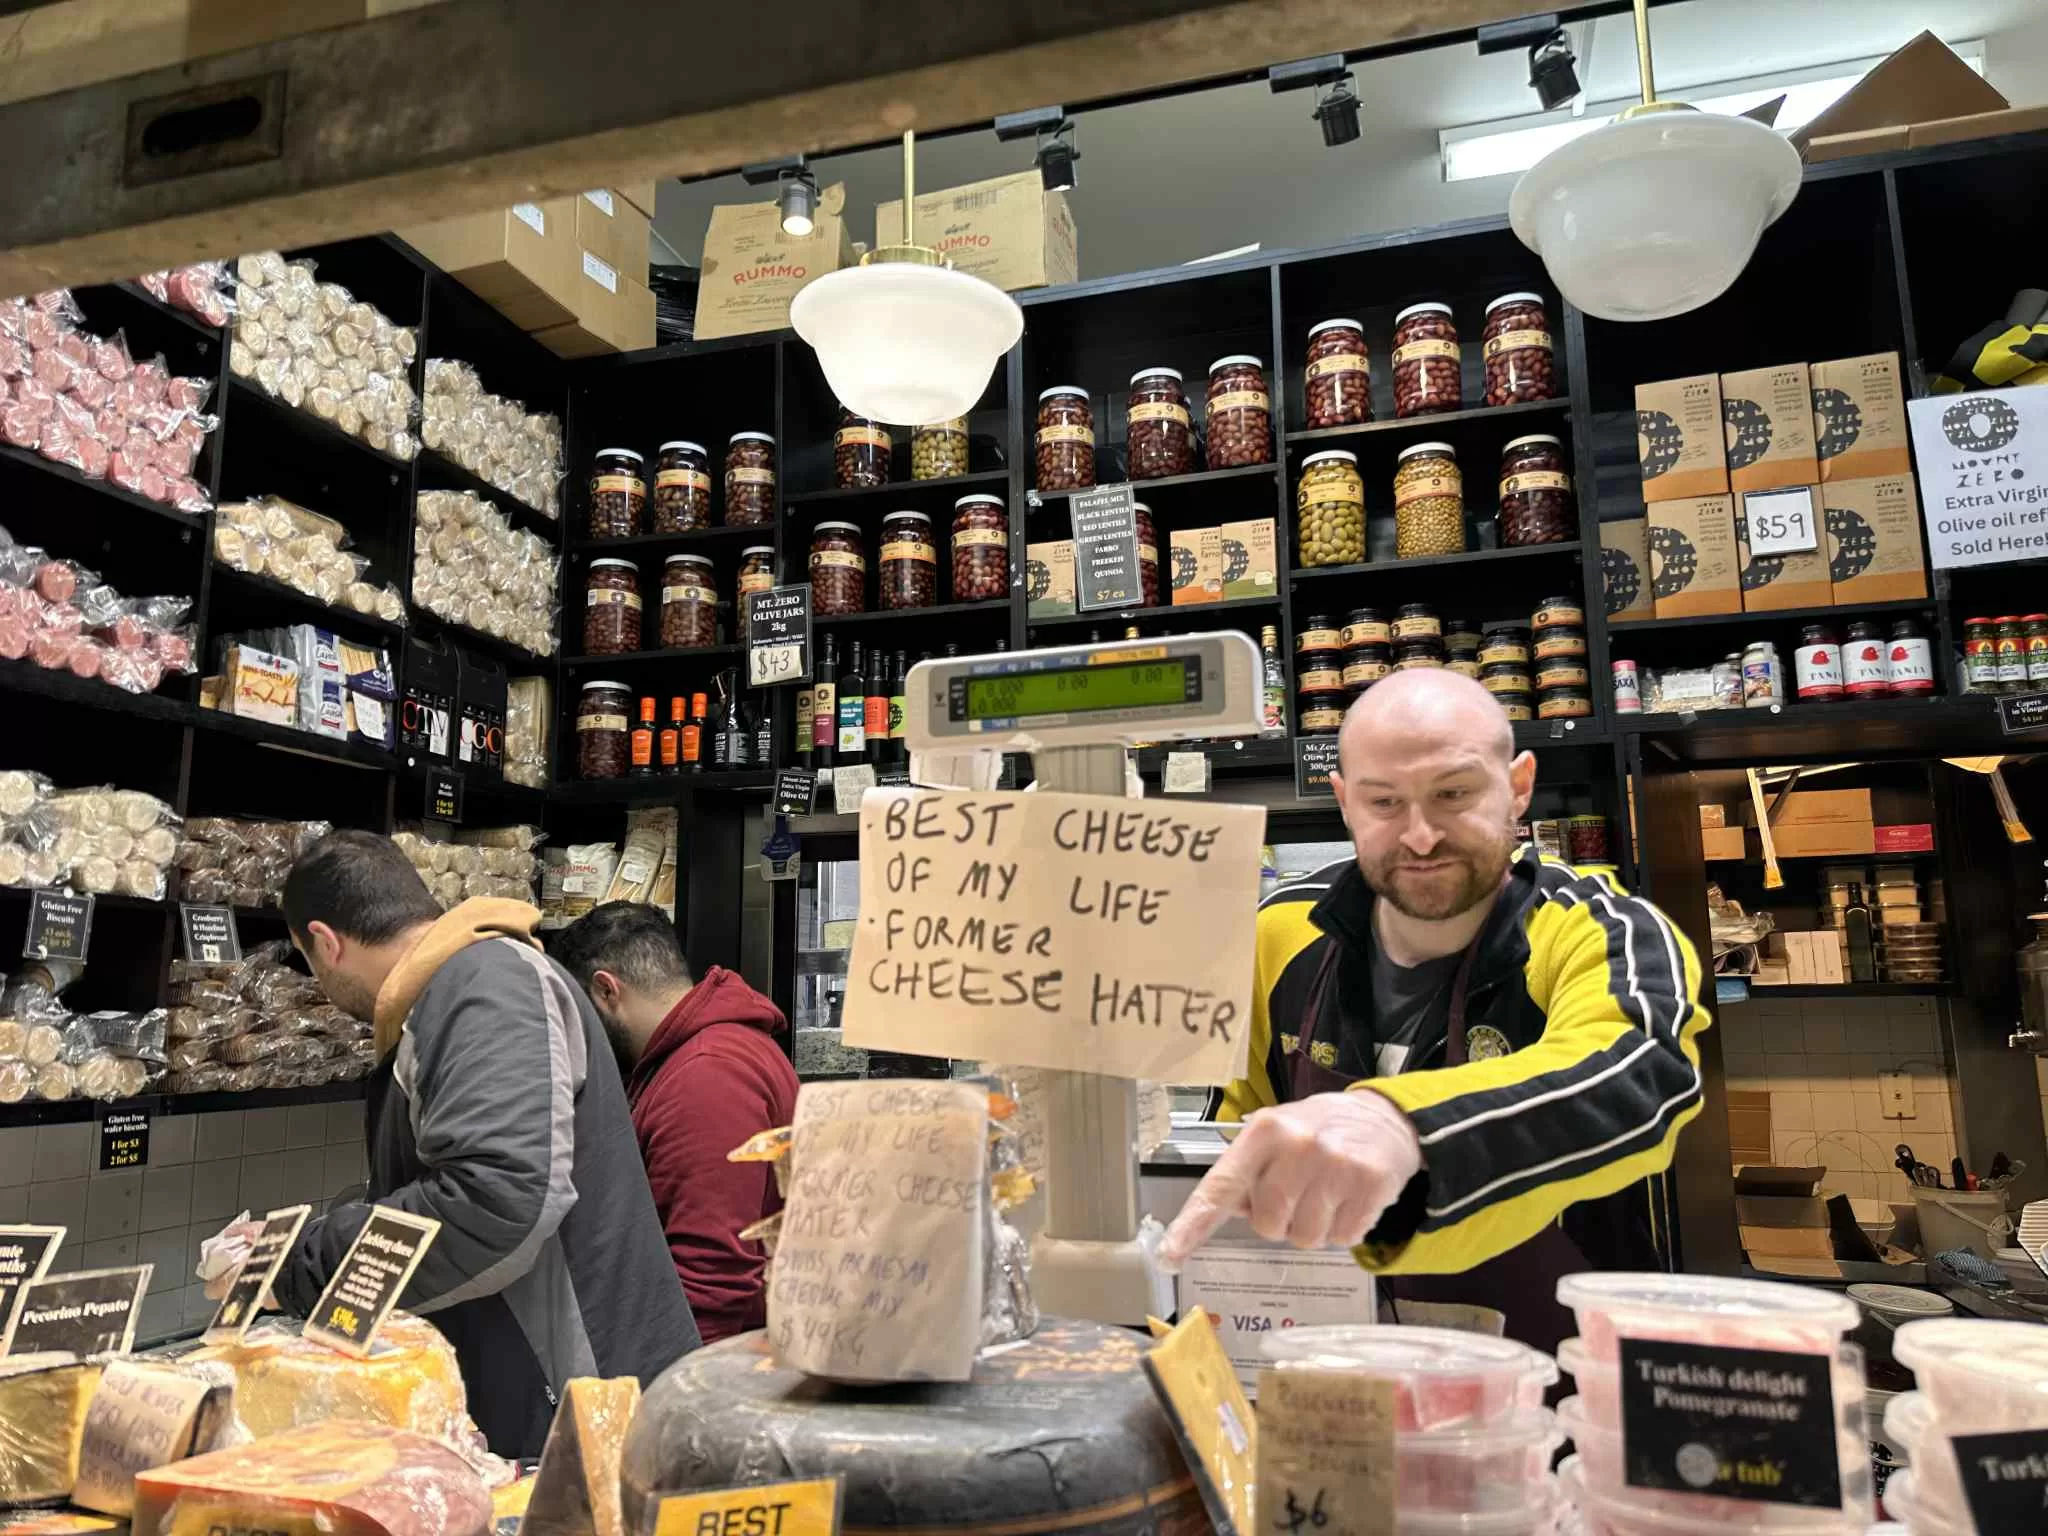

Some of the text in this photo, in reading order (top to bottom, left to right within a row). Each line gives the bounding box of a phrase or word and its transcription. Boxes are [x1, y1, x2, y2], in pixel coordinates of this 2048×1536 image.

[733, 265, 807, 286] RUMMO
[1953, 453, 2021, 470] MOUNT
[1956, 469, 2024, 488] ZERO
[1111, 495, 1125, 503] MIX
[1945, 494, 1995, 510] Extra
[1077, 506, 1130, 521] BLACK LENTILS
[1082, 518, 1127, 531] RED LENTILS
[1755, 512, 1806, 541] $59
[1938, 517, 1986, 534] Olive
[1991, 511, 2015, 528] oil
[1079, 529, 1132, 544] GREEN LENTILS
[1095, 544, 1119, 554] FARRO
[1951, 538, 1992, 556] Sold
[1092, 555, 1124, 566] FREEKEH
[1094, 567, 1124, 578] QUINOA
[757, 596, 800, 609] MT. ZERO
[1097, 590, 1125, 600] $7 ea
[753, 607, 805, 621] OLIVE JARS
[758, 649, 790, 680] $43
[1326, 753, 1339, 762] Jar
[780, 791, 809, 800] Olive Oil
[885, 796, 1222, 863] BEST CHEESE
[887, 851, 1170, 926] OF MY LIFE
[41, 900, 83, 915] Gluten Free
[46, 912, 75, 924] Biscuits
[192, 914, 224, 923] Cranberry
[886, 909, 1052, 958] FORMER
[868, 958, 1237, 1044] CHEESE HATER
[867, 1087, 956, 1121] CHEESE
[108, 1115, 130, 1125] Gluten
[124, 1122, 148, 1132] biscuits
[118, 1140, 129, 1149] for
[892, 1122, 945, 1154] LIFE
[117, 1155, 128, 1165] for
[896, 1171, 982, 1213] CHEESE
[787, 1205, 872, 1239] HATER
[22, 1300, 130, 1325] Pecorino Pepato
[1232, 1314, 1272, 1332] VISA
[1635, 1360, 1808, 1397] Turkish delight
[1653, 1385, 1800, 1422] Pomegranate
[1737, 1460, 1784, 1486] tub
[697, 1503, 791, 1536] BEST
[1273, 1488, 1330, 1535] $6
